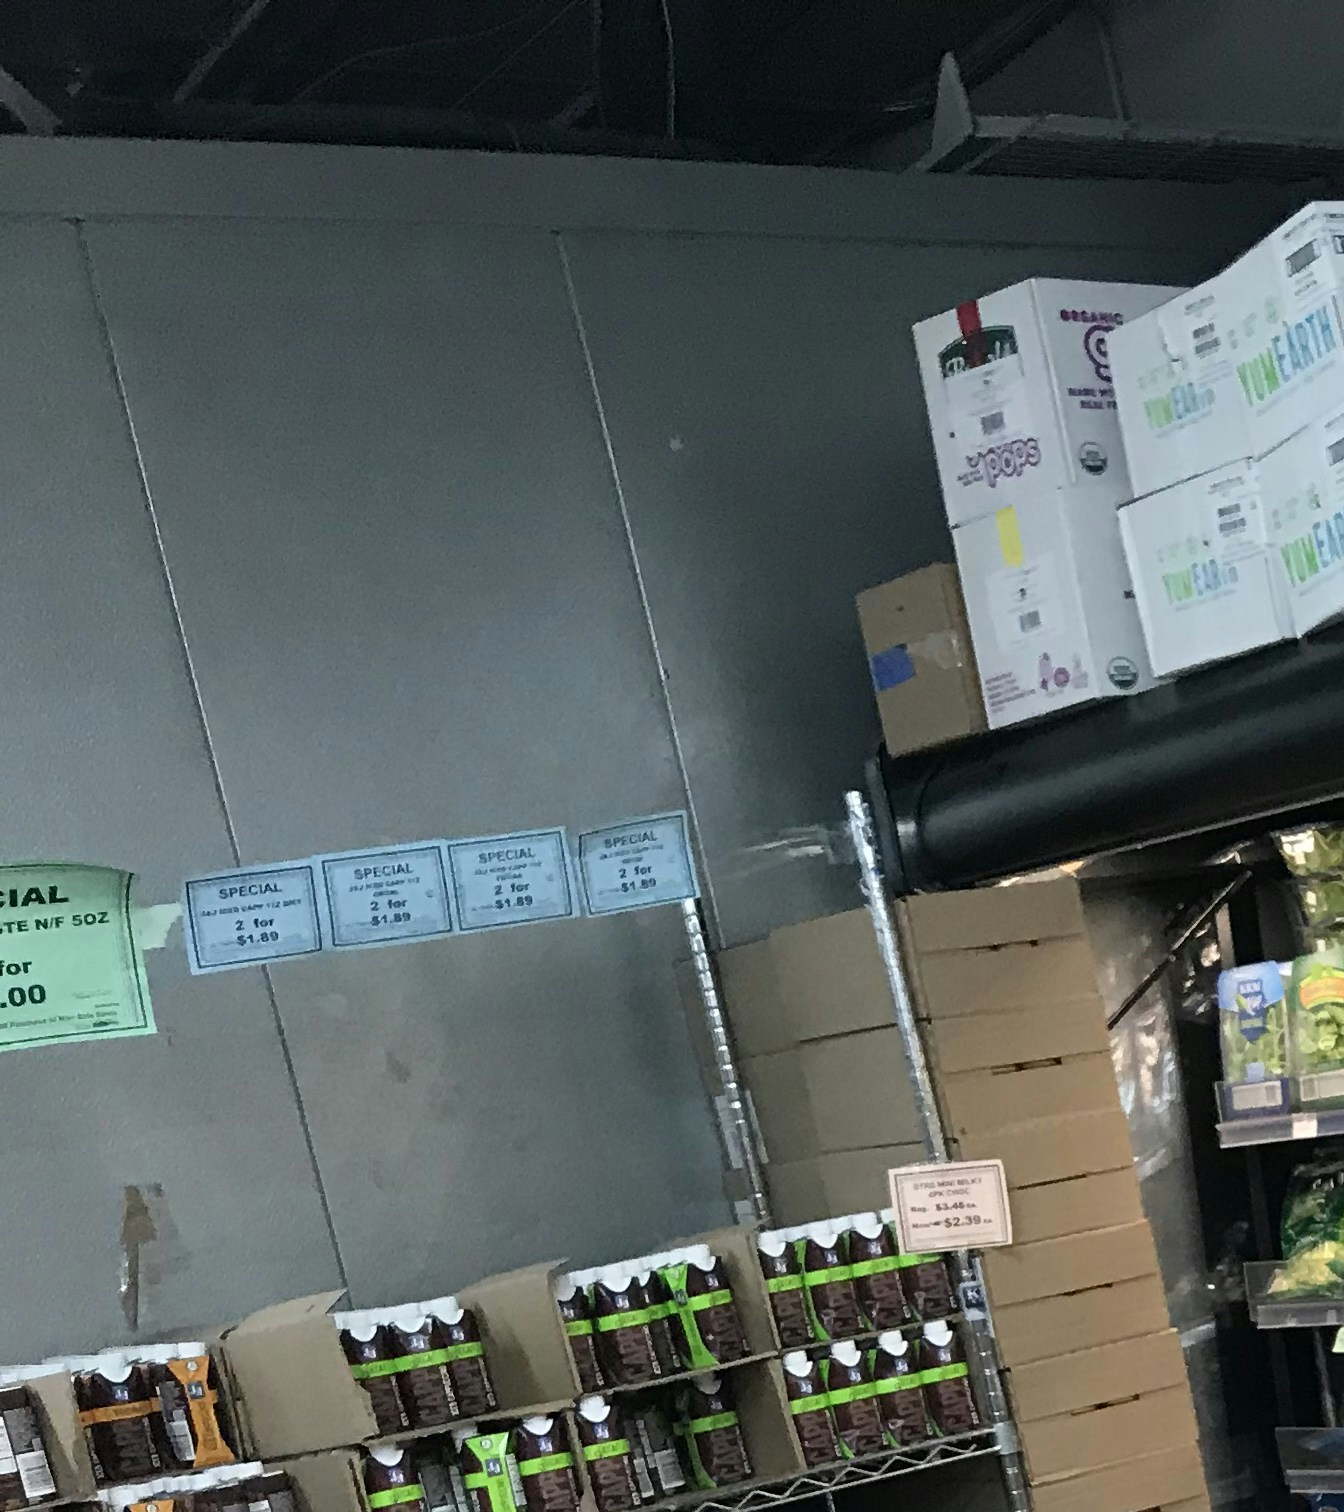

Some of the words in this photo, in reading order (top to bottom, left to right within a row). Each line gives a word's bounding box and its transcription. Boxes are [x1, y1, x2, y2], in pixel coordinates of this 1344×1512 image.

[603, 831, 658, 848] SPECIAL
[479, 848, 536, 864] SPECIAL
[354, 863, 414, 880] SPECIAL
[618, 868, 627, 878] 2
[219, 883, 282, 900] SPECIAL
[494, 884, 504, 895] 2
[511, 883, 530, 893] for
[370, 901, 379, 911] 2
[388, 899, 408, 909] for
[235, 920, 244, 931] 2
[254, 918, 275, 928] for
